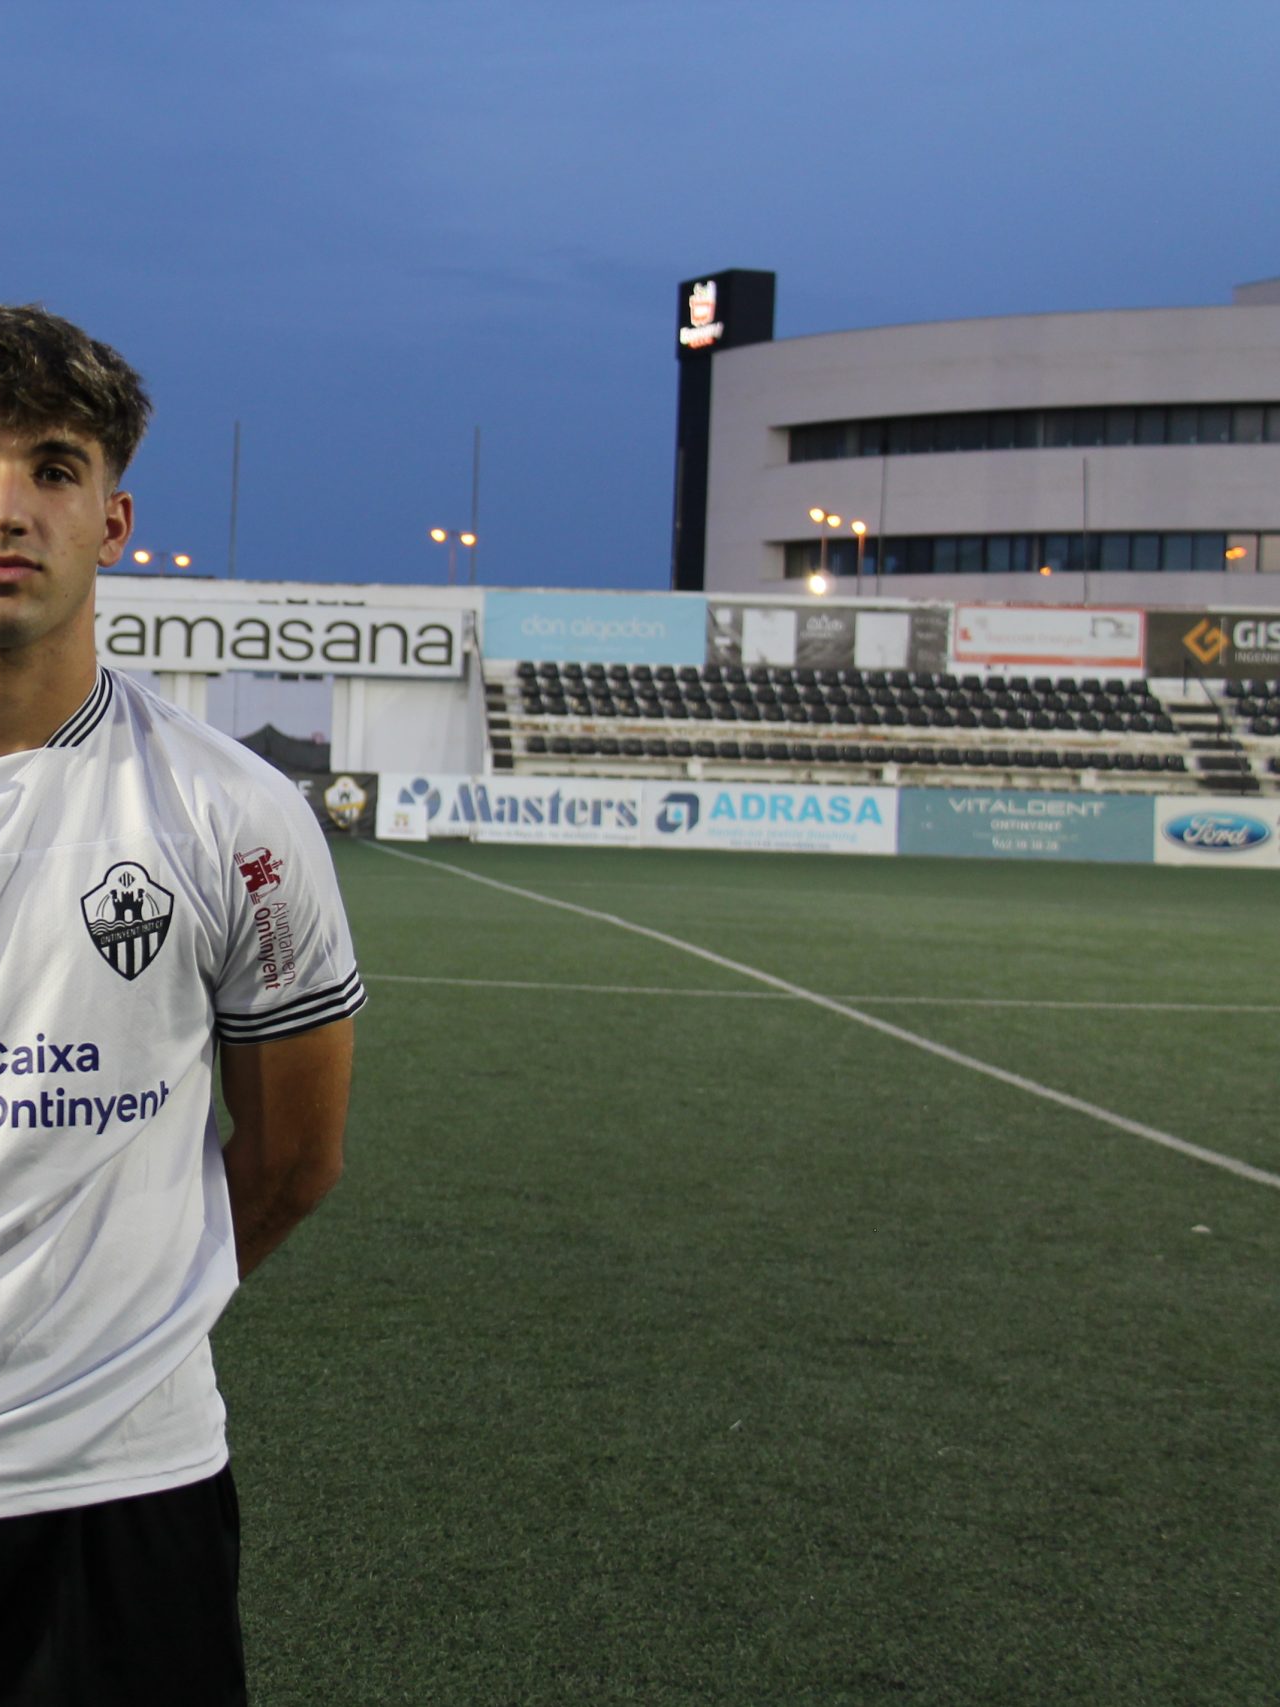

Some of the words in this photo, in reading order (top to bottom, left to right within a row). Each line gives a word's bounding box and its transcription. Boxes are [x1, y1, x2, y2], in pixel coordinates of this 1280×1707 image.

[95, 612, 454, 666] amasana
[521, 614, 564, 636] don
[449, 782, 639, 828] Masters
[709, 790, 883, 825] ADRASA
[947, 797, 1106, 817] VITALDENT
[1183, 815, 1250, 846] Ford
[254, 907, 280, 990] Ontinyent
